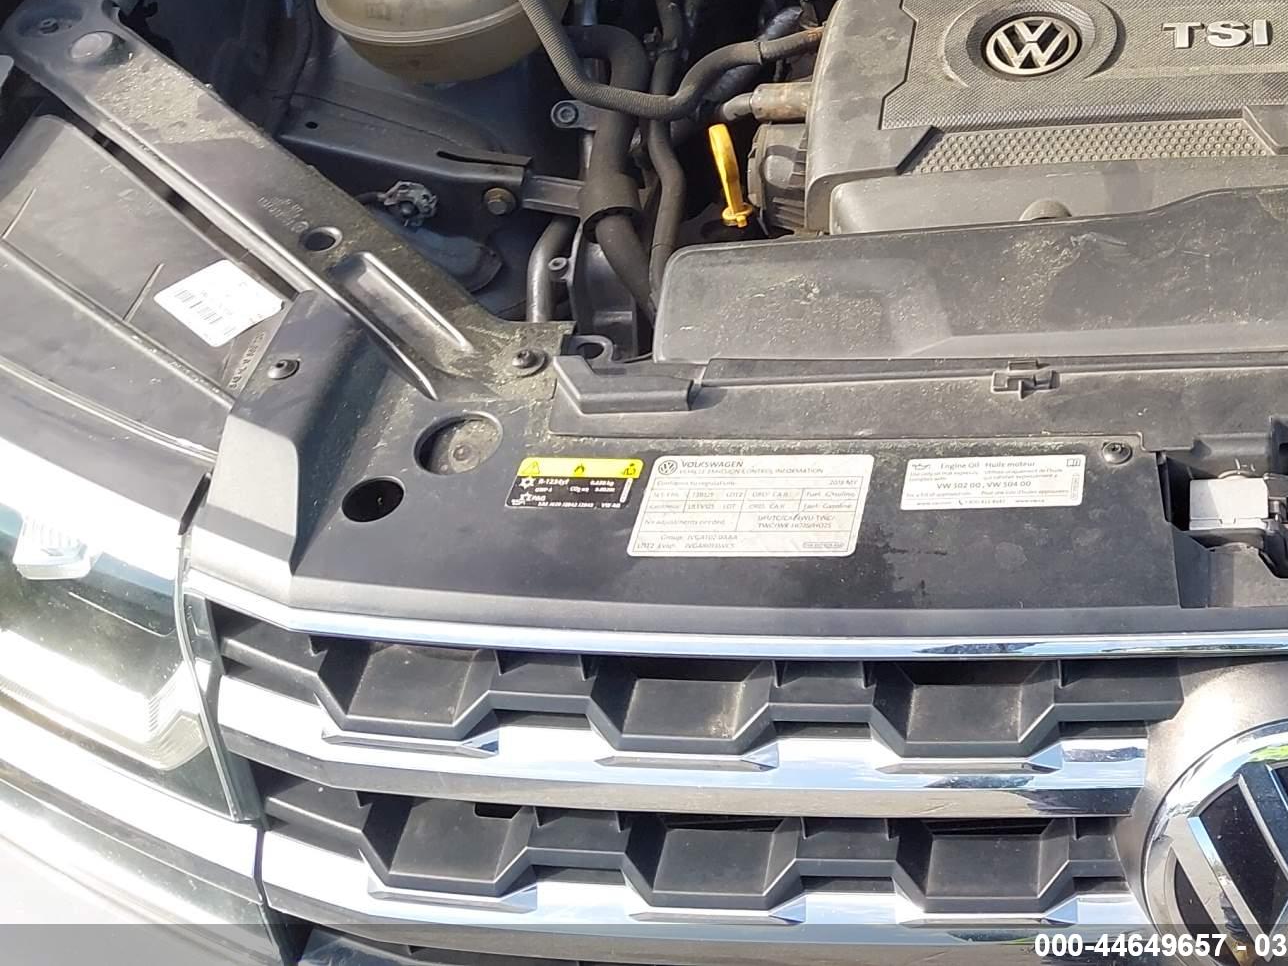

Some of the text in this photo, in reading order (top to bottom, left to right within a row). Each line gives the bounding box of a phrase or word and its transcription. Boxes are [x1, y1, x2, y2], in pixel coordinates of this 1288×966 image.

[1161, 19, 1271, 49] TSI
[986, 15, 1078, 75] VW
[681, 460, 744, 468] VOLKSWAGEN
[940, 462, 966, 470] Engine
